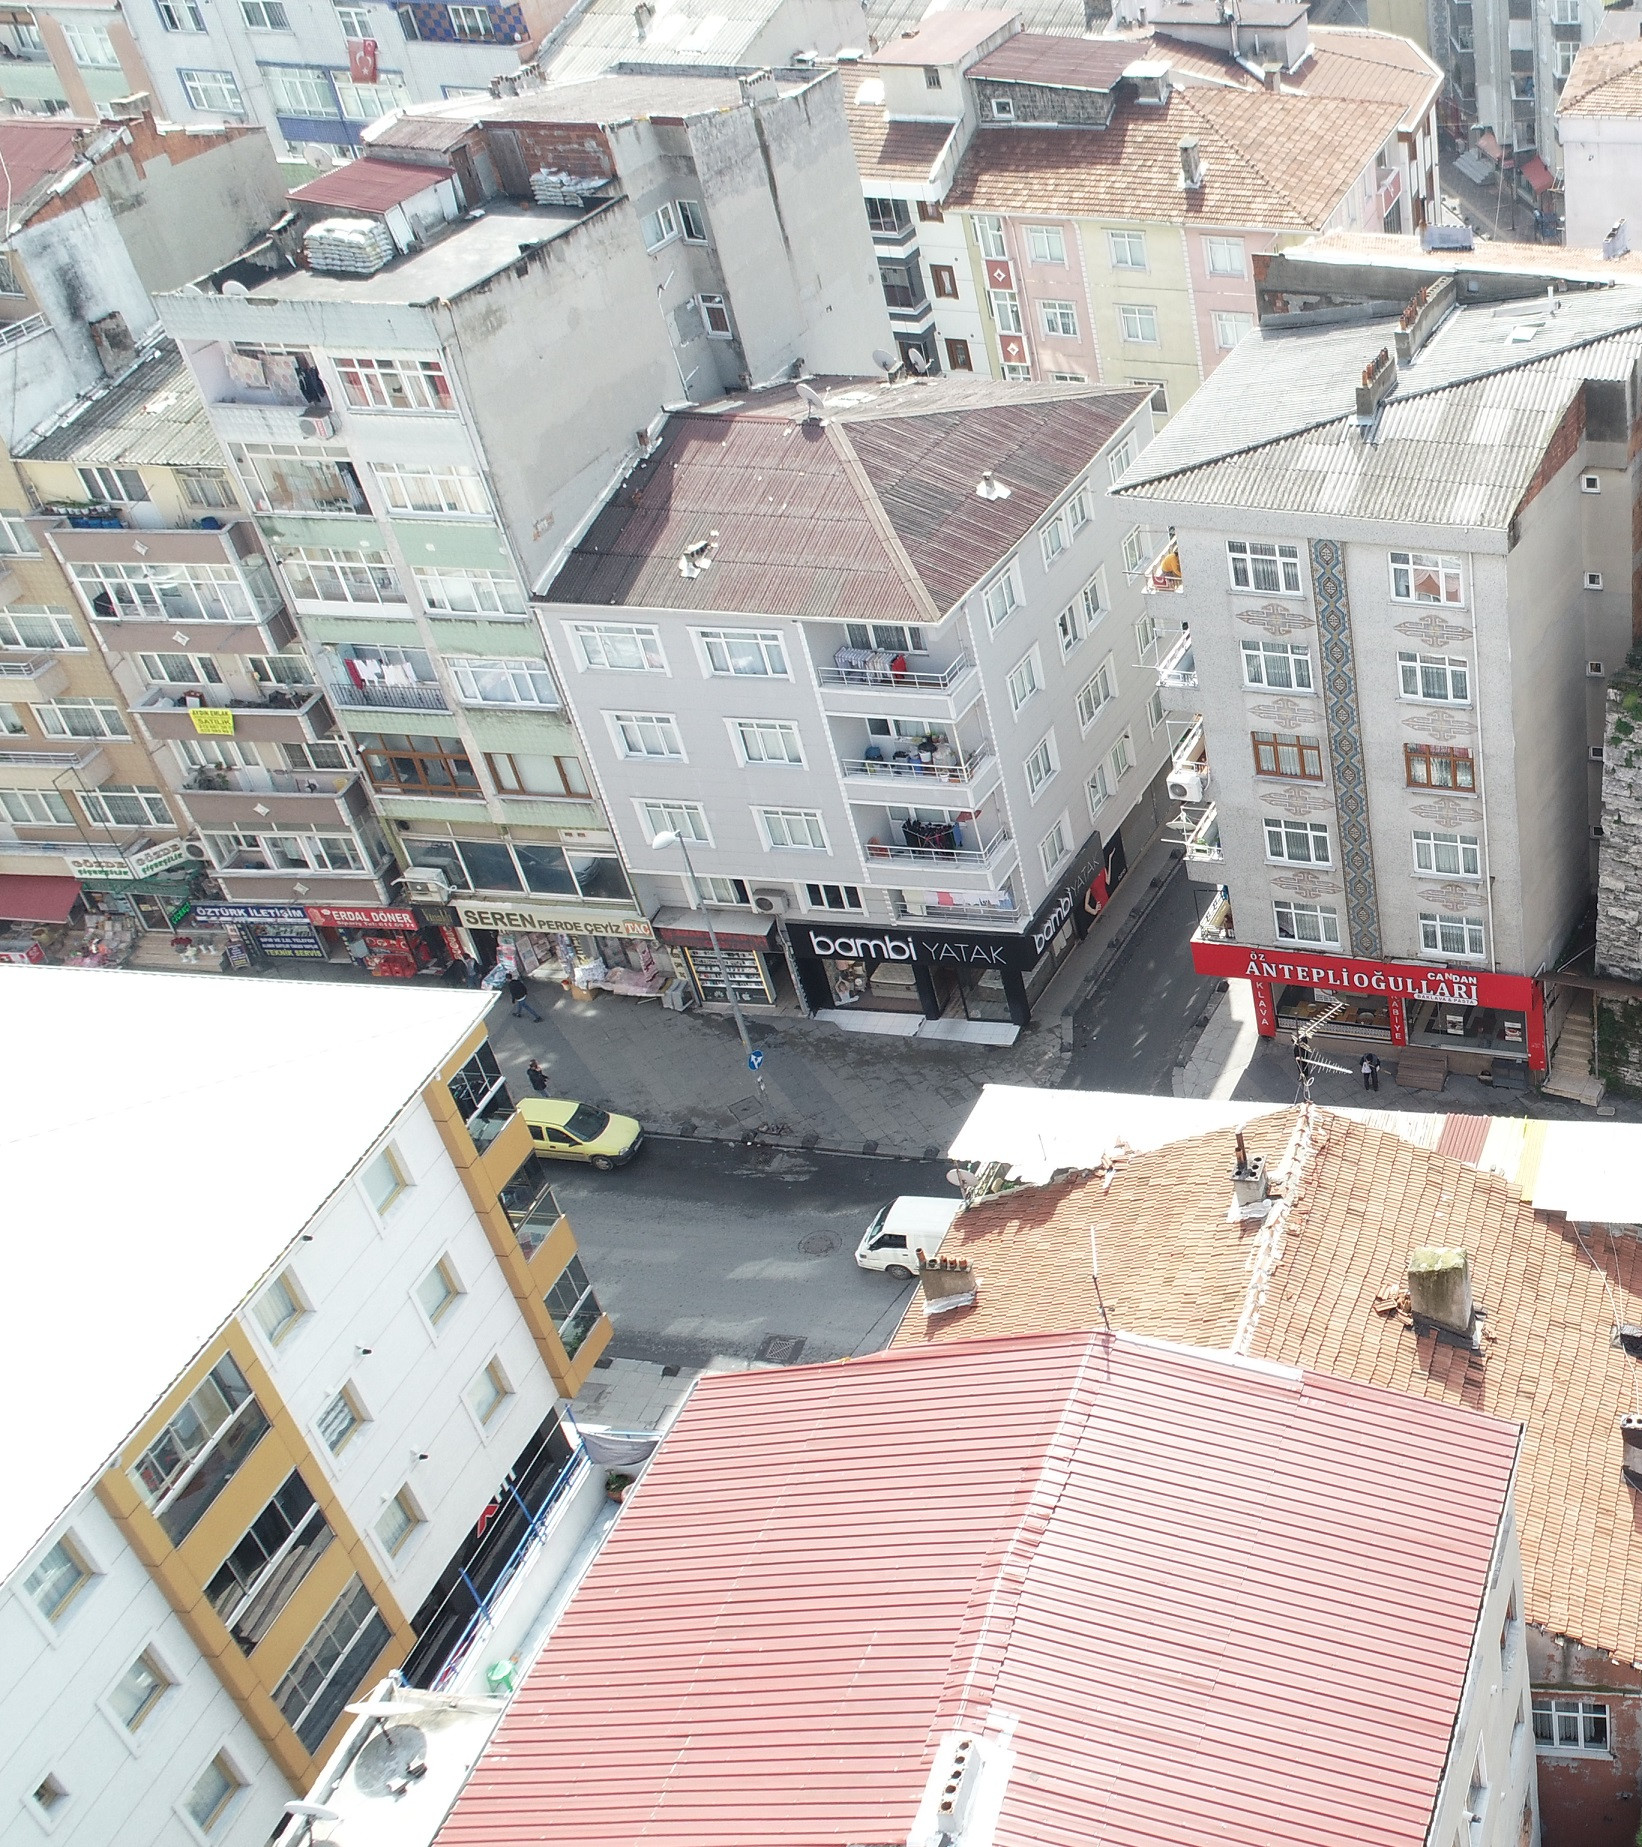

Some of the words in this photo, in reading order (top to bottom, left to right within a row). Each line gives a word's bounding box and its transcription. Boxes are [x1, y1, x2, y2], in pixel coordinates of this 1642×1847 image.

[136, 844, 181, 866] GÖZDE
[72, 859, 128, 869] GÖZDE
[1032, 887, 1074, 954] bambi
[1071, 850, 1099, 896] YATAK
[197, 907, 246, 917] ÖZTÜRK
[248, 907, 303, 918] İLETİŞİM
[332, 911, 370, 922] ERDAL
[371, 911, 412, 923] DÖNER
[463, 910, 537, 929] SEREN
[537, 920, 582, 932] PERDE
[584, 921, 623, 935] ÇEYİZ
[809, 930, 917, 961] bambi
[922, 941, 1007, 965] YATAK
[1250, 951, 1266, 961] ÖZ
[1246, 961, 1478, 1000] ANTEPLİOĞULLARI
[1427, 972, 1477, 984] CANDAN
